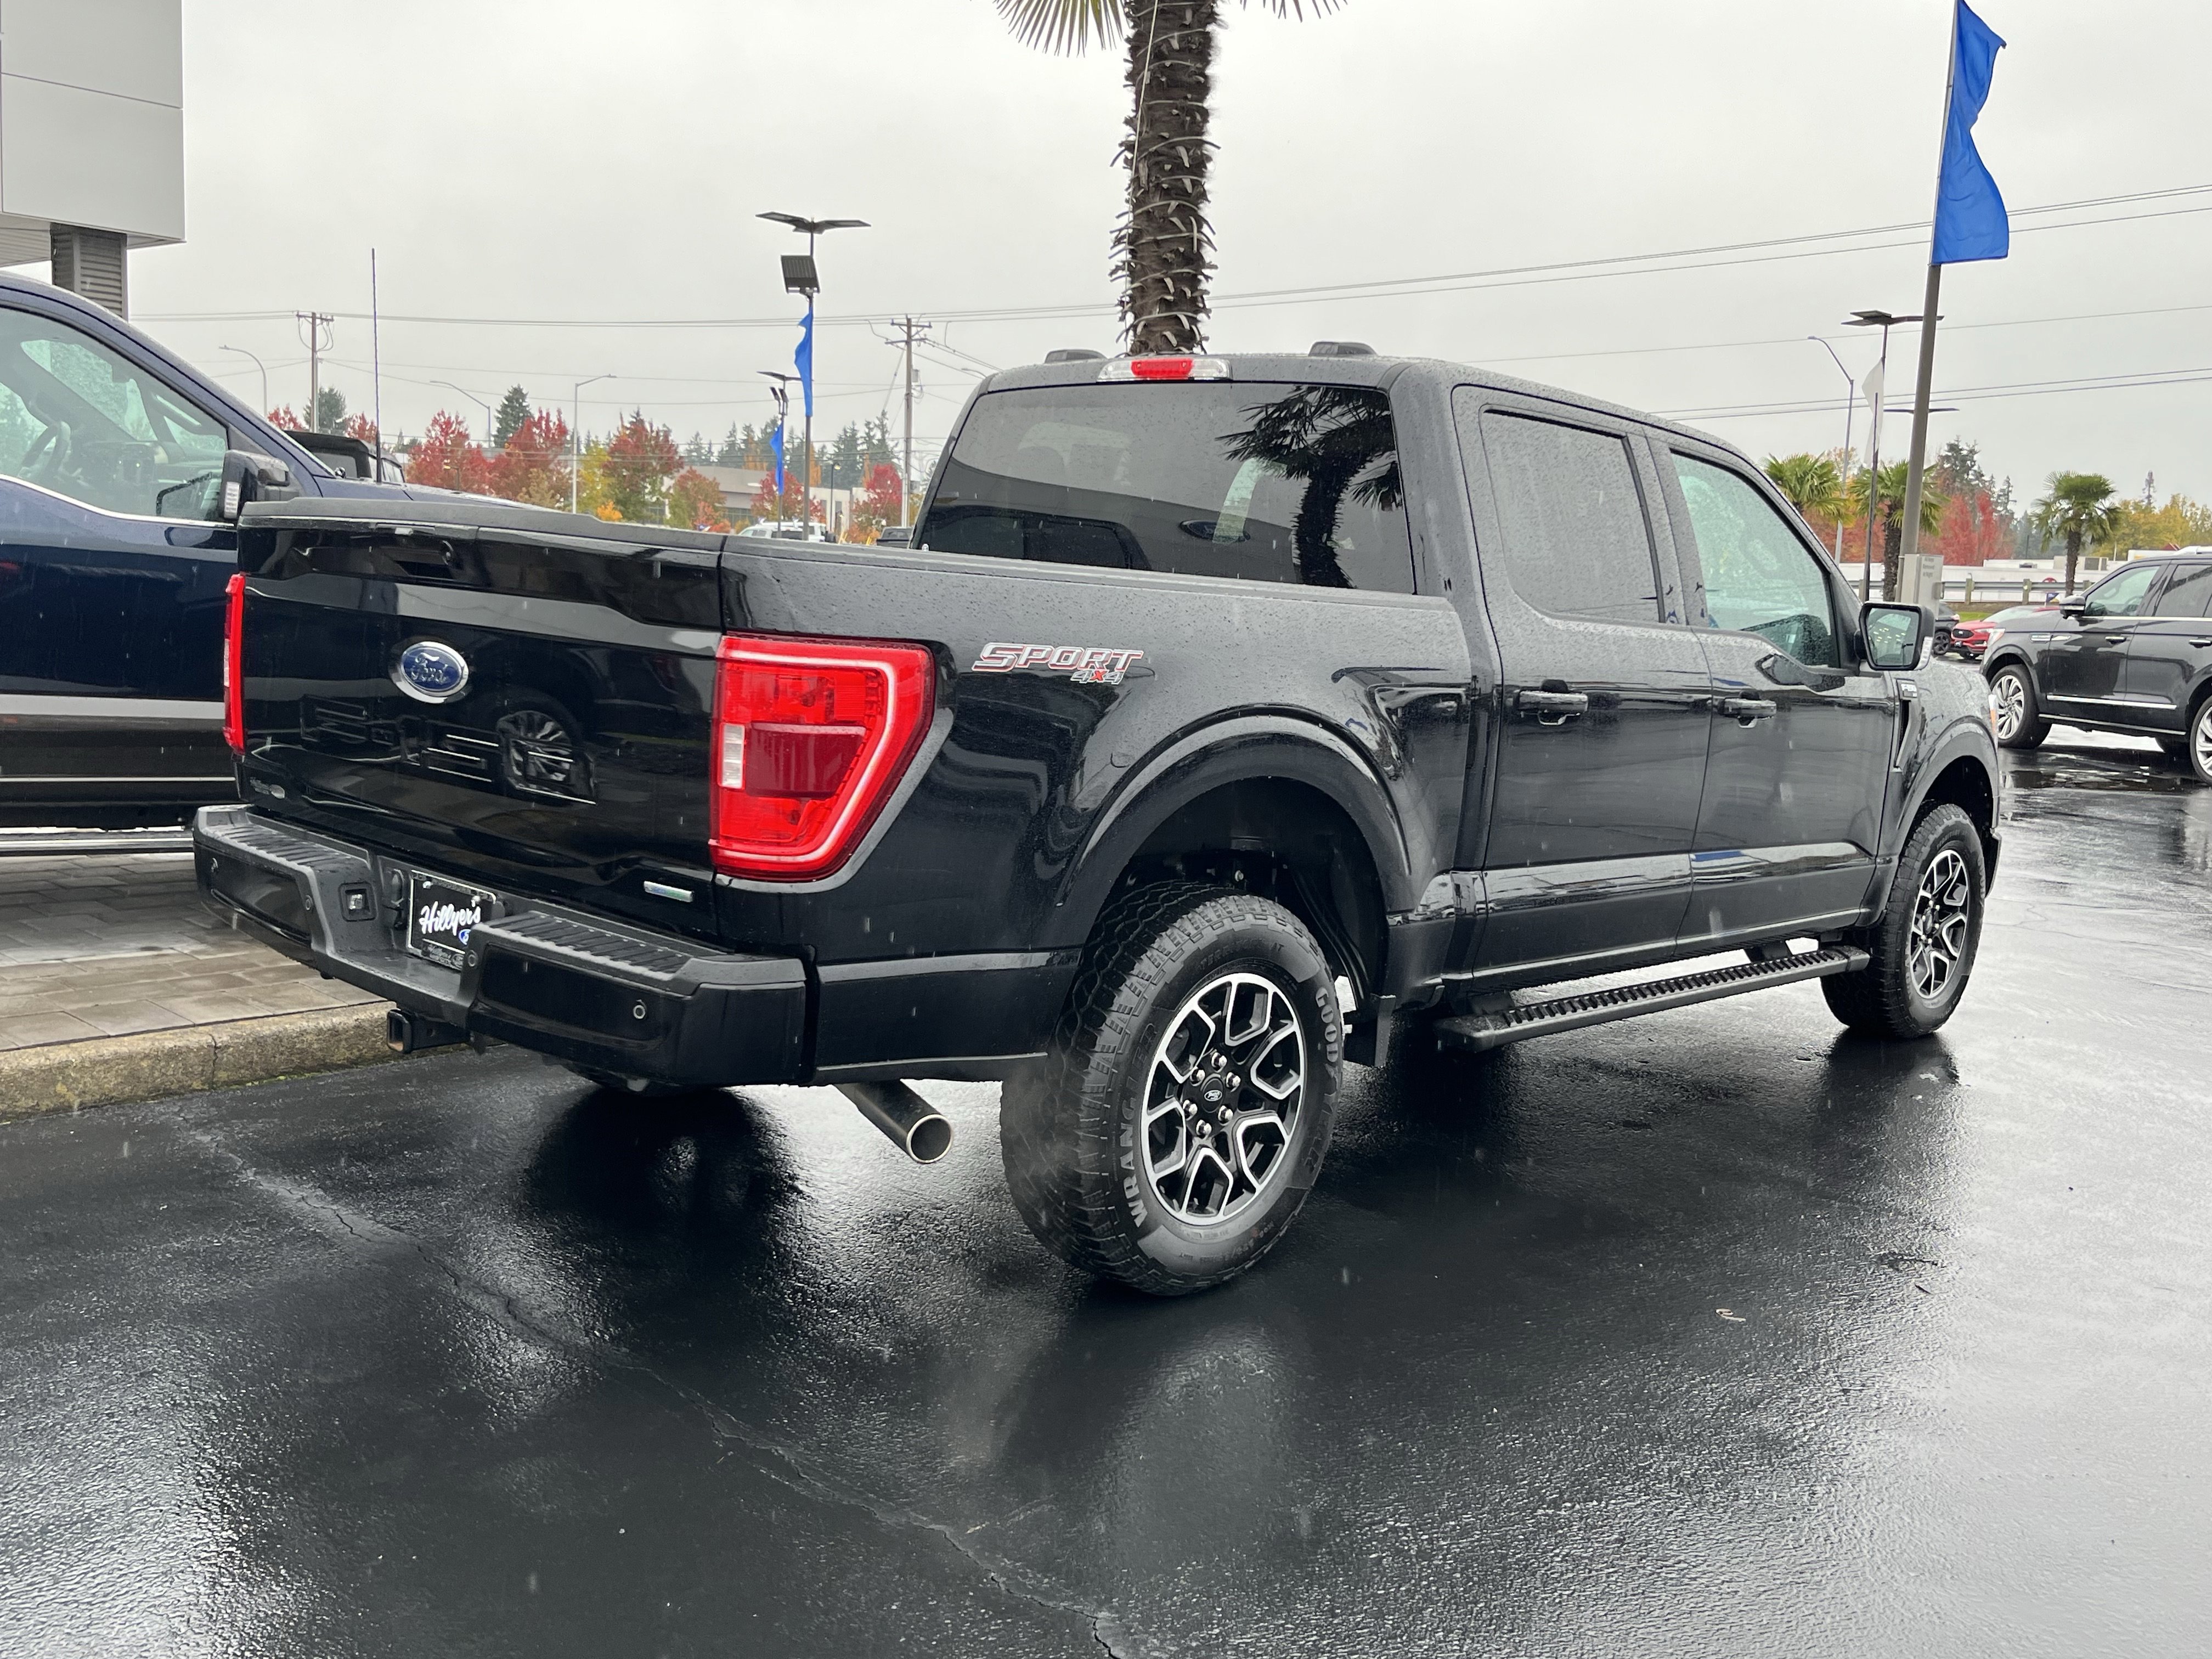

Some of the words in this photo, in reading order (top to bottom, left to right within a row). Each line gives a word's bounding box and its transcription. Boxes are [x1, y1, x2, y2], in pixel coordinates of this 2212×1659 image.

[411, 652, 452, 685] Ford
[972, 642, 1144, 673] SPORT
[419, 899, 481, 936] Hillyer's
[1304, 988, 1339, 1173] GOODYEAR
[1119, 1023, 1158, 1228] WRANGLER
